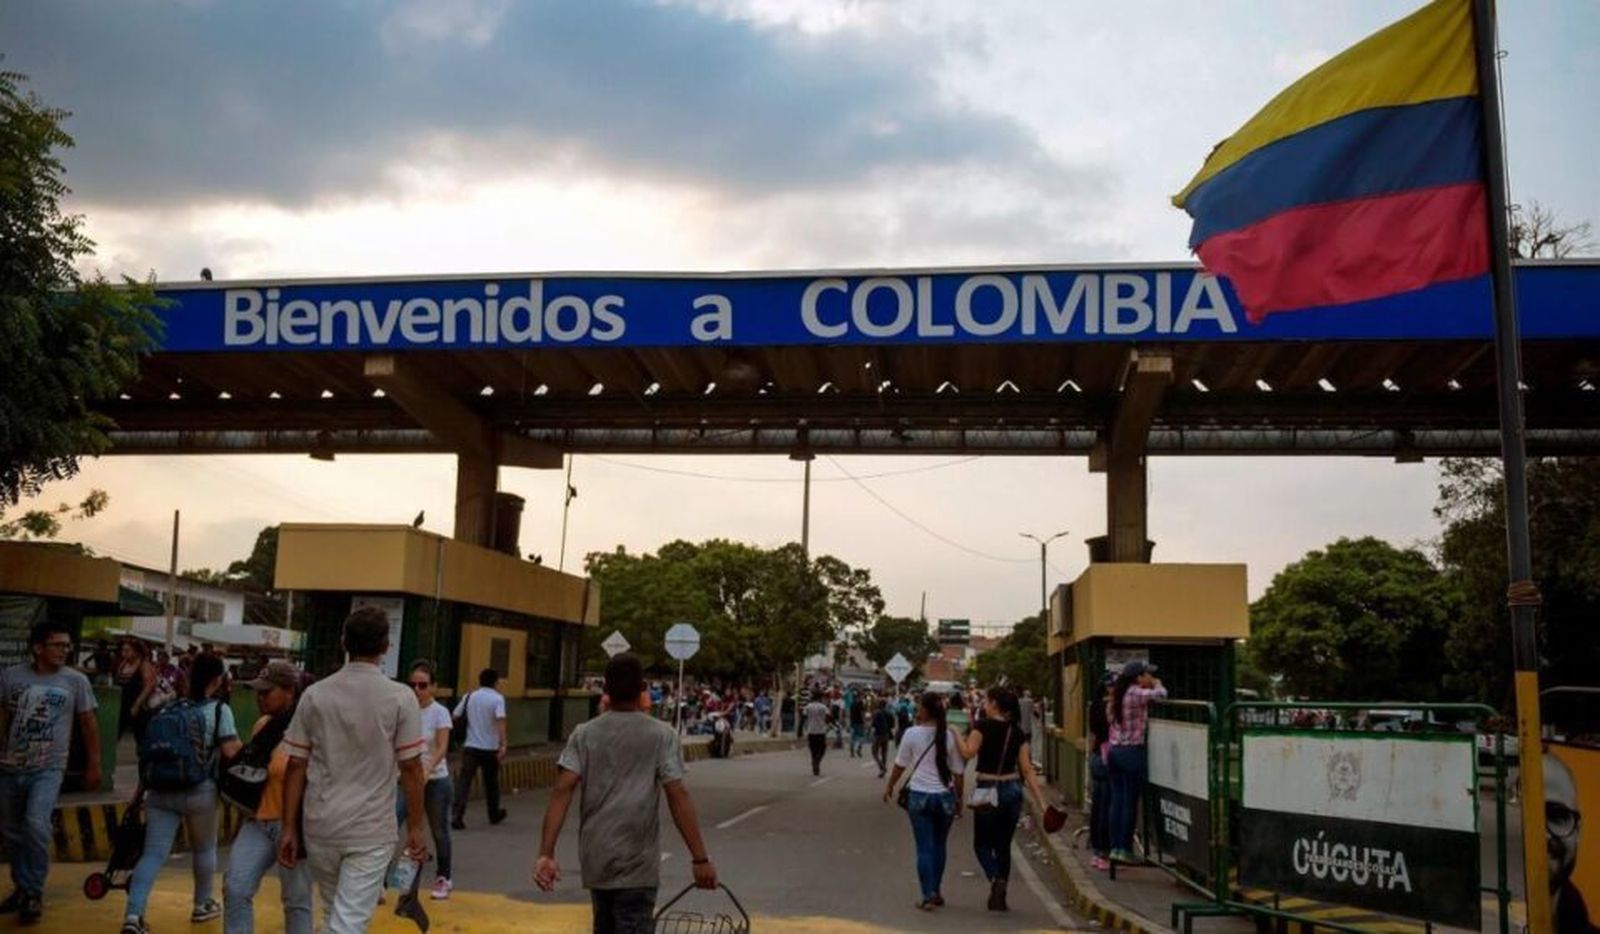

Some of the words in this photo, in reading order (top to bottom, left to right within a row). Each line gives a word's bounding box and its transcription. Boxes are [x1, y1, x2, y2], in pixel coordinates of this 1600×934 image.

[224, 279, 626, 346] Bienvenidos
[690, 293, 734, 341] a
[801, 272, 1238, 337] COLOMBIA
[1294, 831, 1412, 892] CÚCUTA
